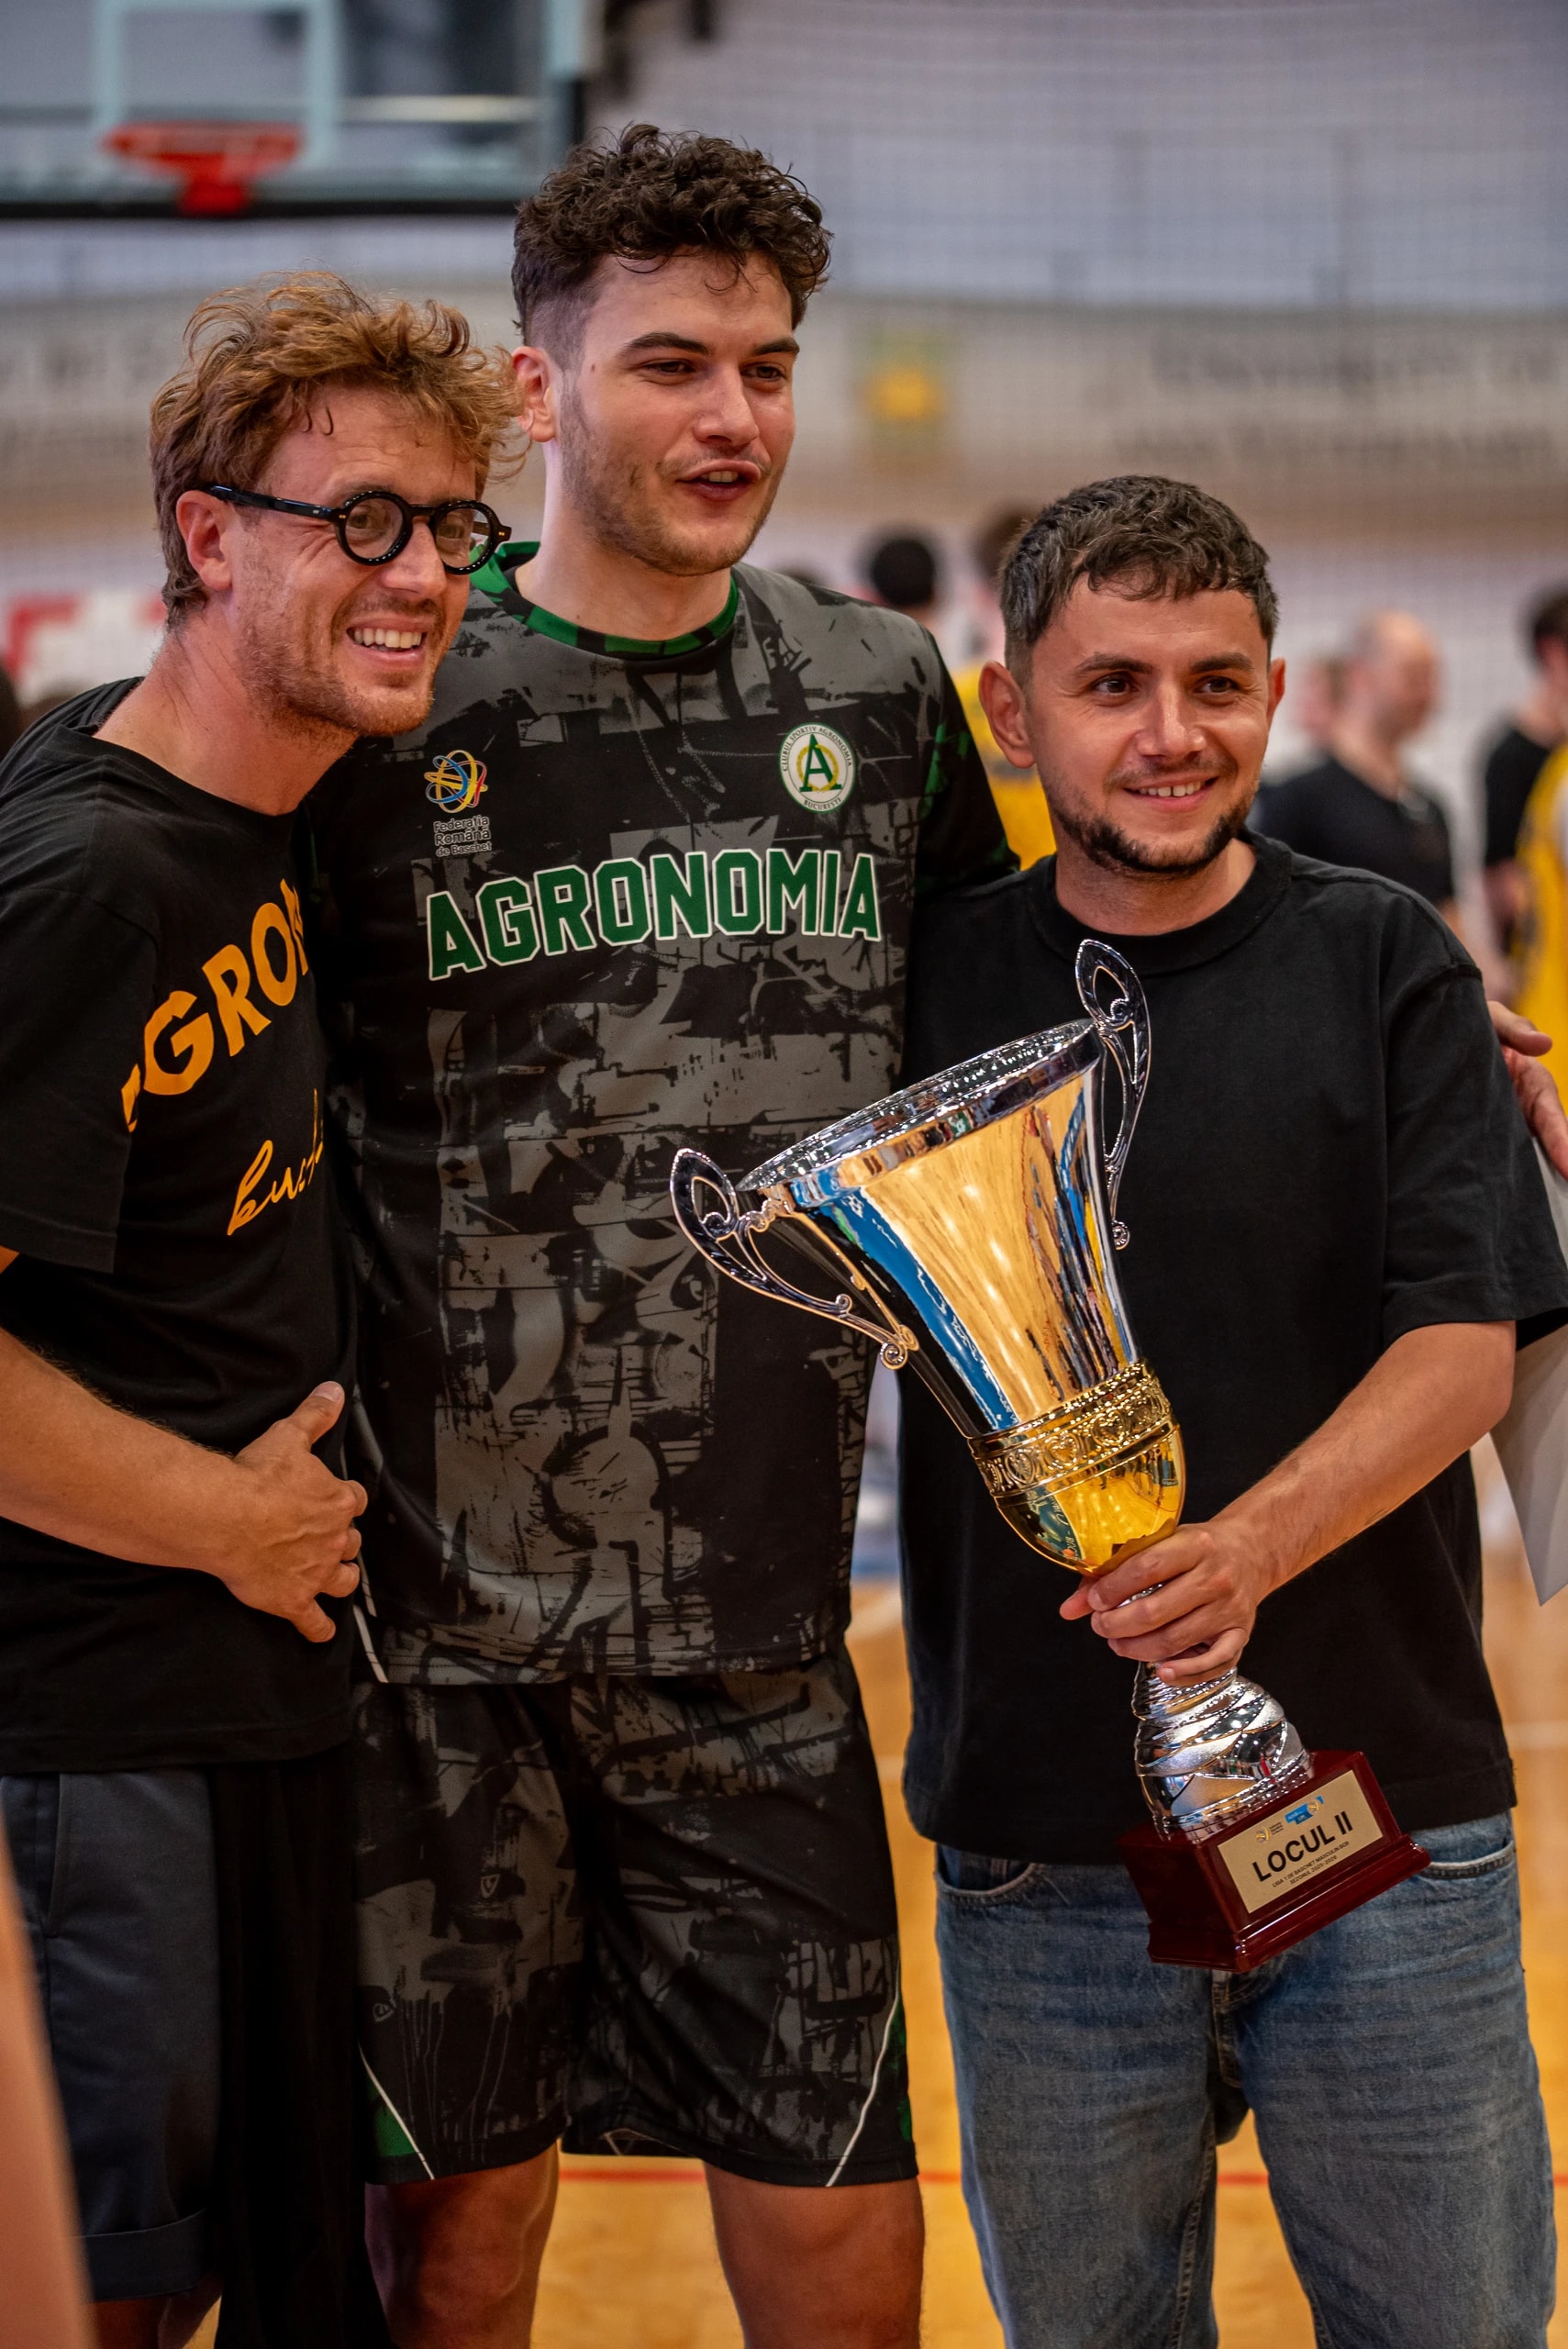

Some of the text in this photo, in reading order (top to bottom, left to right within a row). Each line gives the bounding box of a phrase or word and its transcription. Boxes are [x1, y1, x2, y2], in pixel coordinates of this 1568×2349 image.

[781, 726, 852, 772] CLUBUL SPORTIV AGRONOMIA
[436, 841, 492, 857] de Baschet
[427, 848, 882, 981] AGRONOMIA
[1251, 1810, 1353, 1882] LOCUL II
